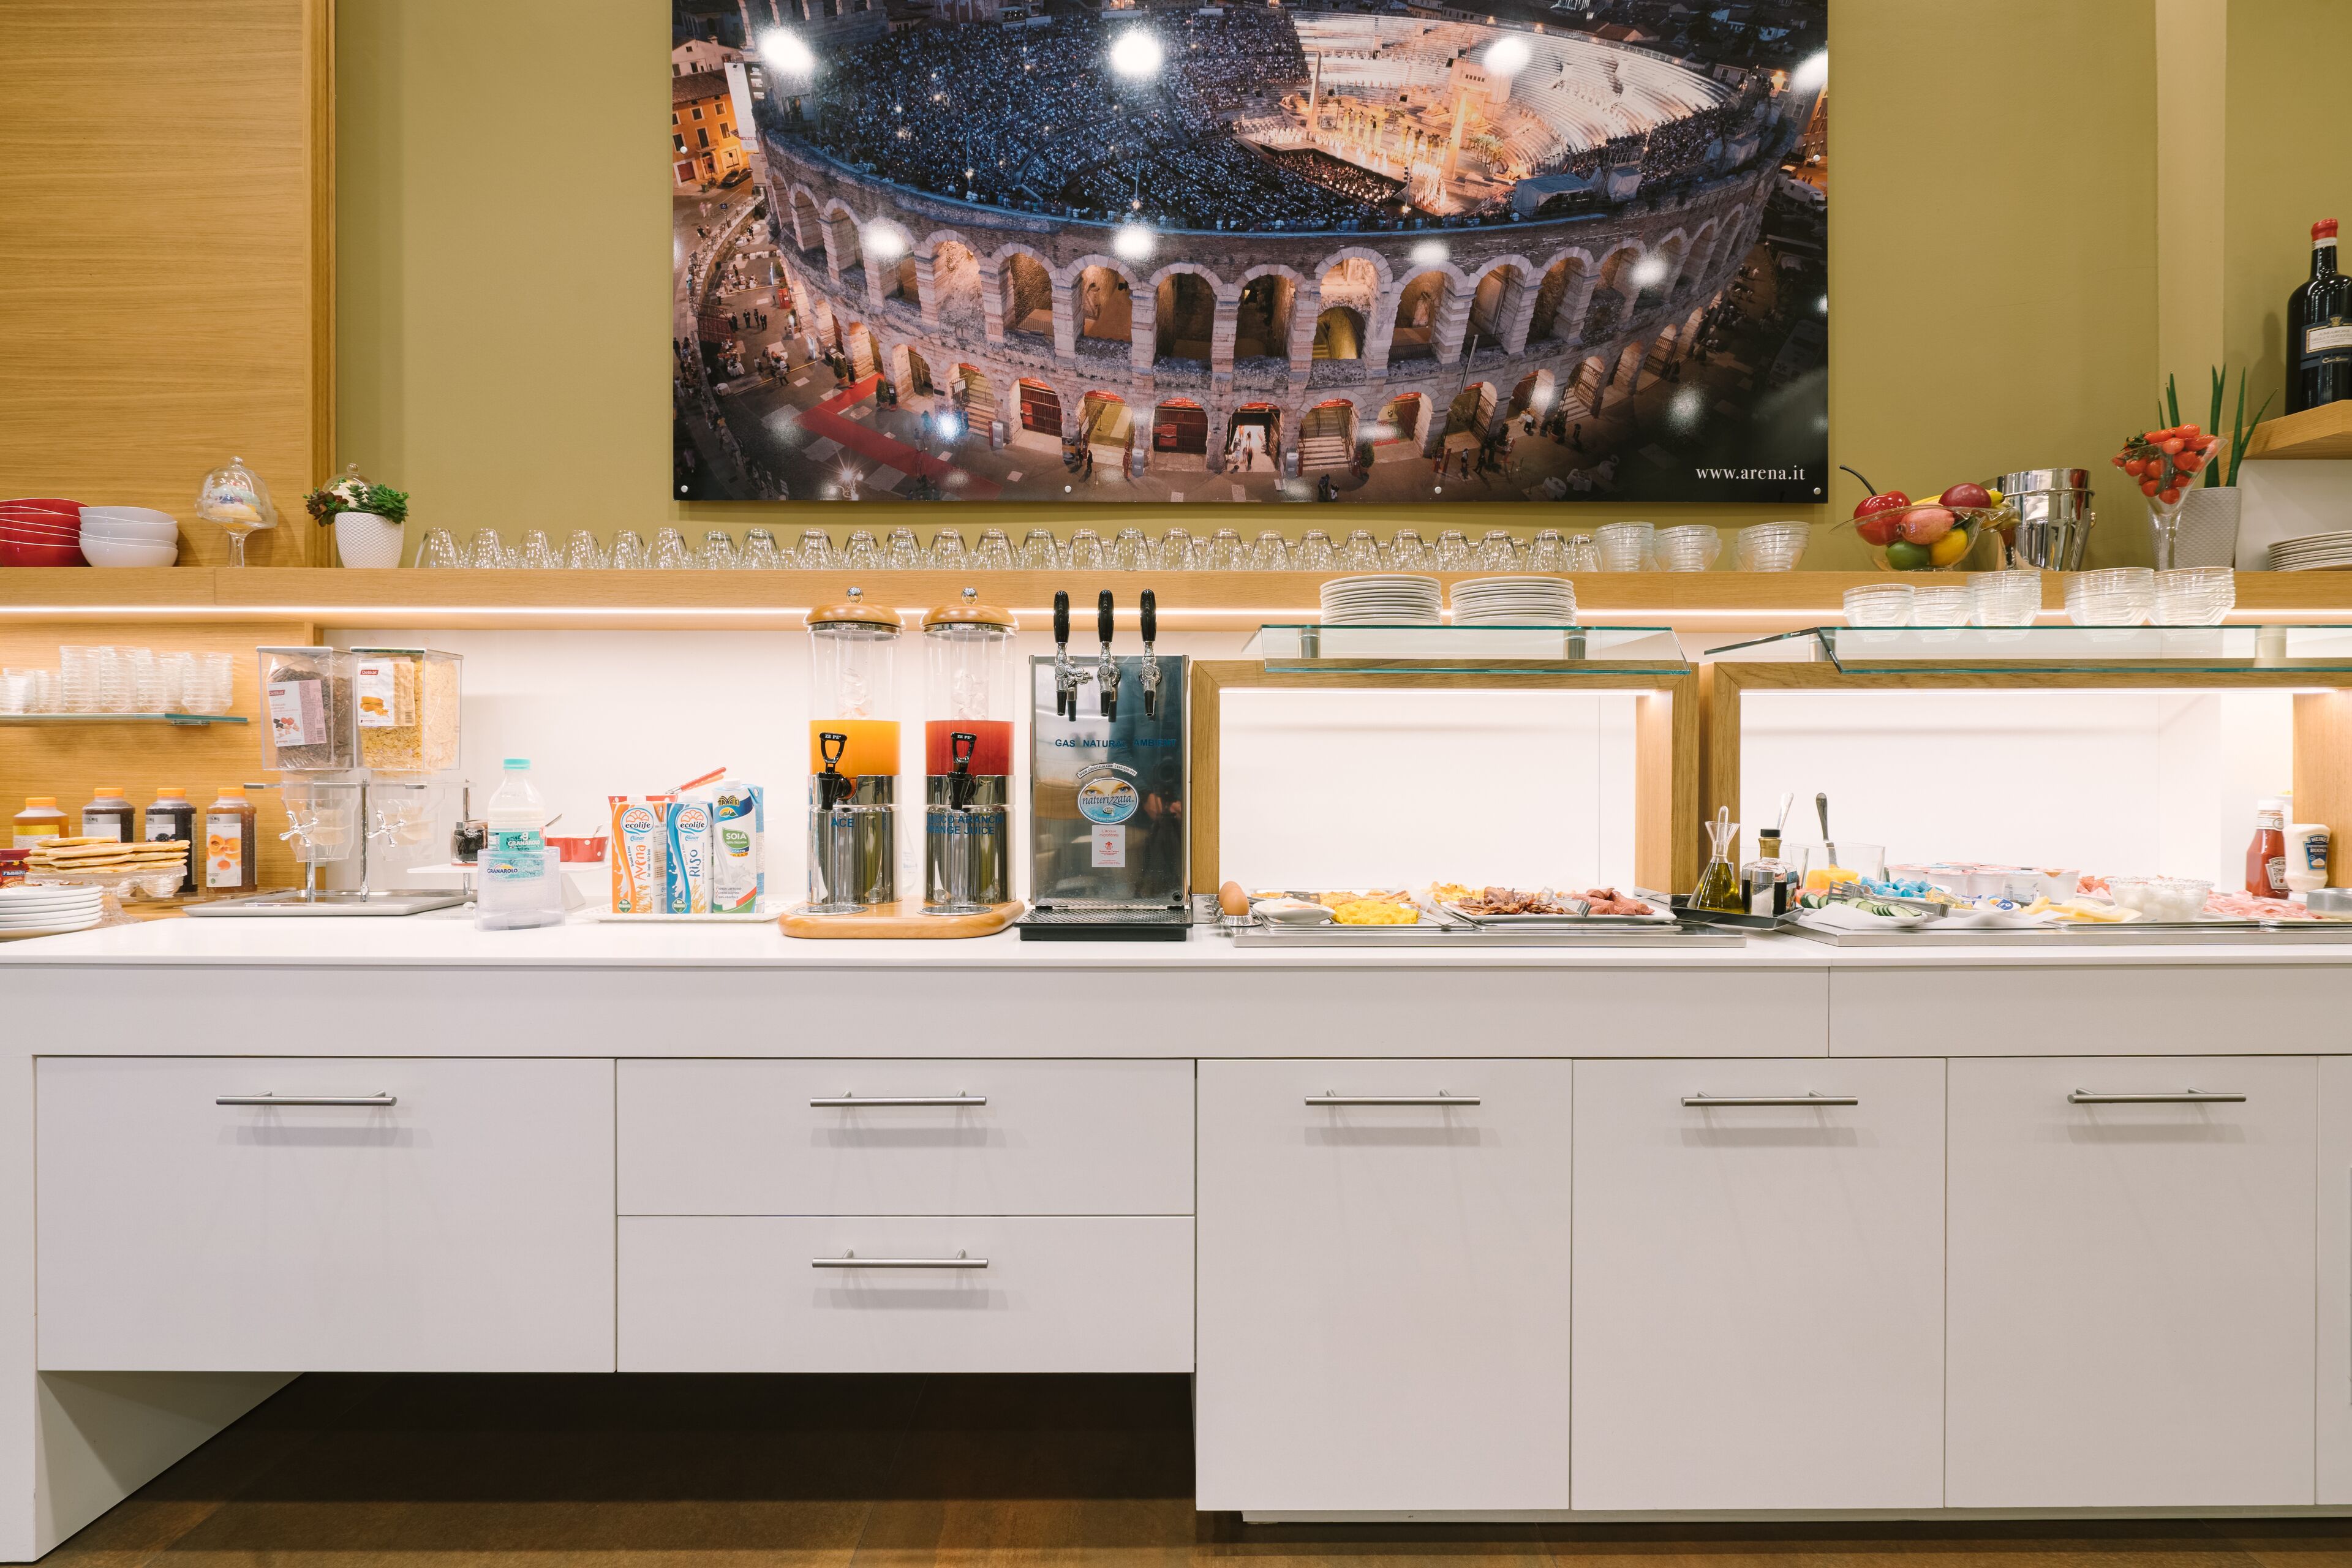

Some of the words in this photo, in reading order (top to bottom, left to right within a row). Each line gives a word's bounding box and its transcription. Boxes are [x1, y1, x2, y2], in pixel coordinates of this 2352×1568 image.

[1695, 466, 1806, 480] www.arena.it
[1055, 739, 1076, 747] GAS
[1082, 794, 1131, 805] naturizzata
[625, 821, 650, 829] ecolife
[831, 818, 854, 827] ACE
[964, 826, 995, 835] JUICE
[633, 845, 647, 881] Avena
